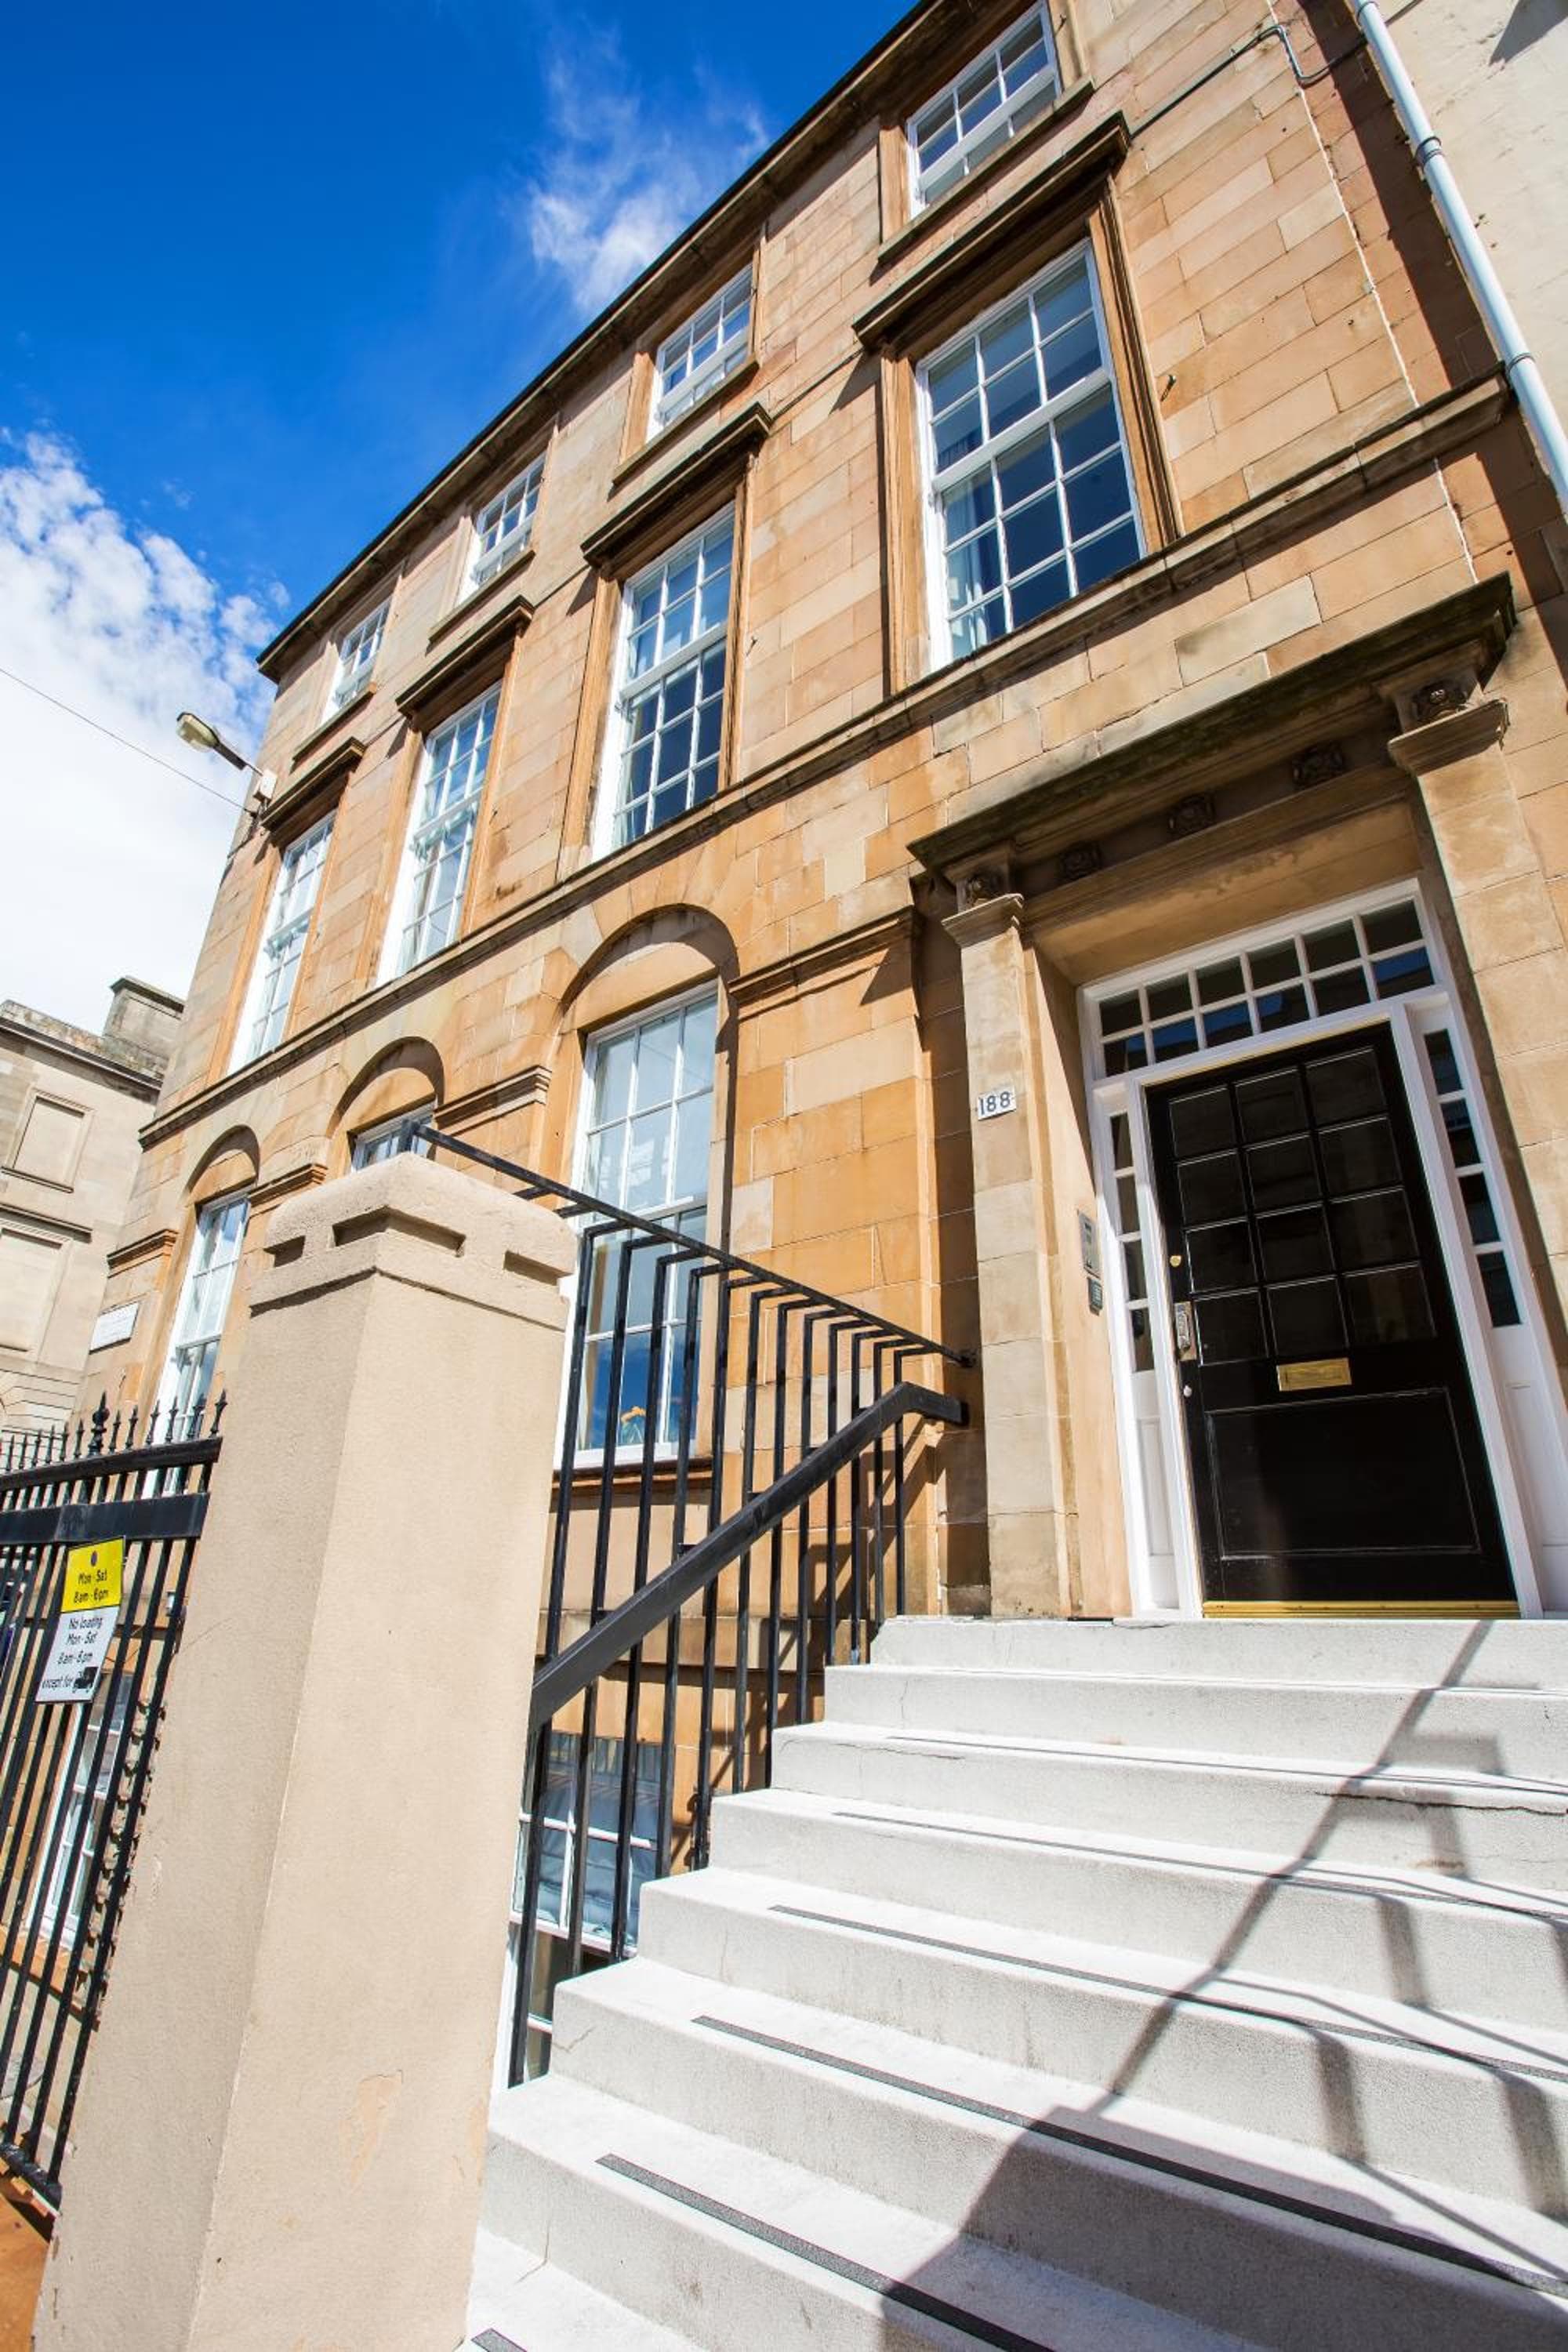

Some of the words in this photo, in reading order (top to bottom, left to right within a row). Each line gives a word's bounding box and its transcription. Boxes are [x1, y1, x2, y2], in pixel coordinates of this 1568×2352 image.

[981, 1091, 1010, 1115] 188
[69, 1618, 78, 1629] No
[80, 1617, 103, 1629] loading
